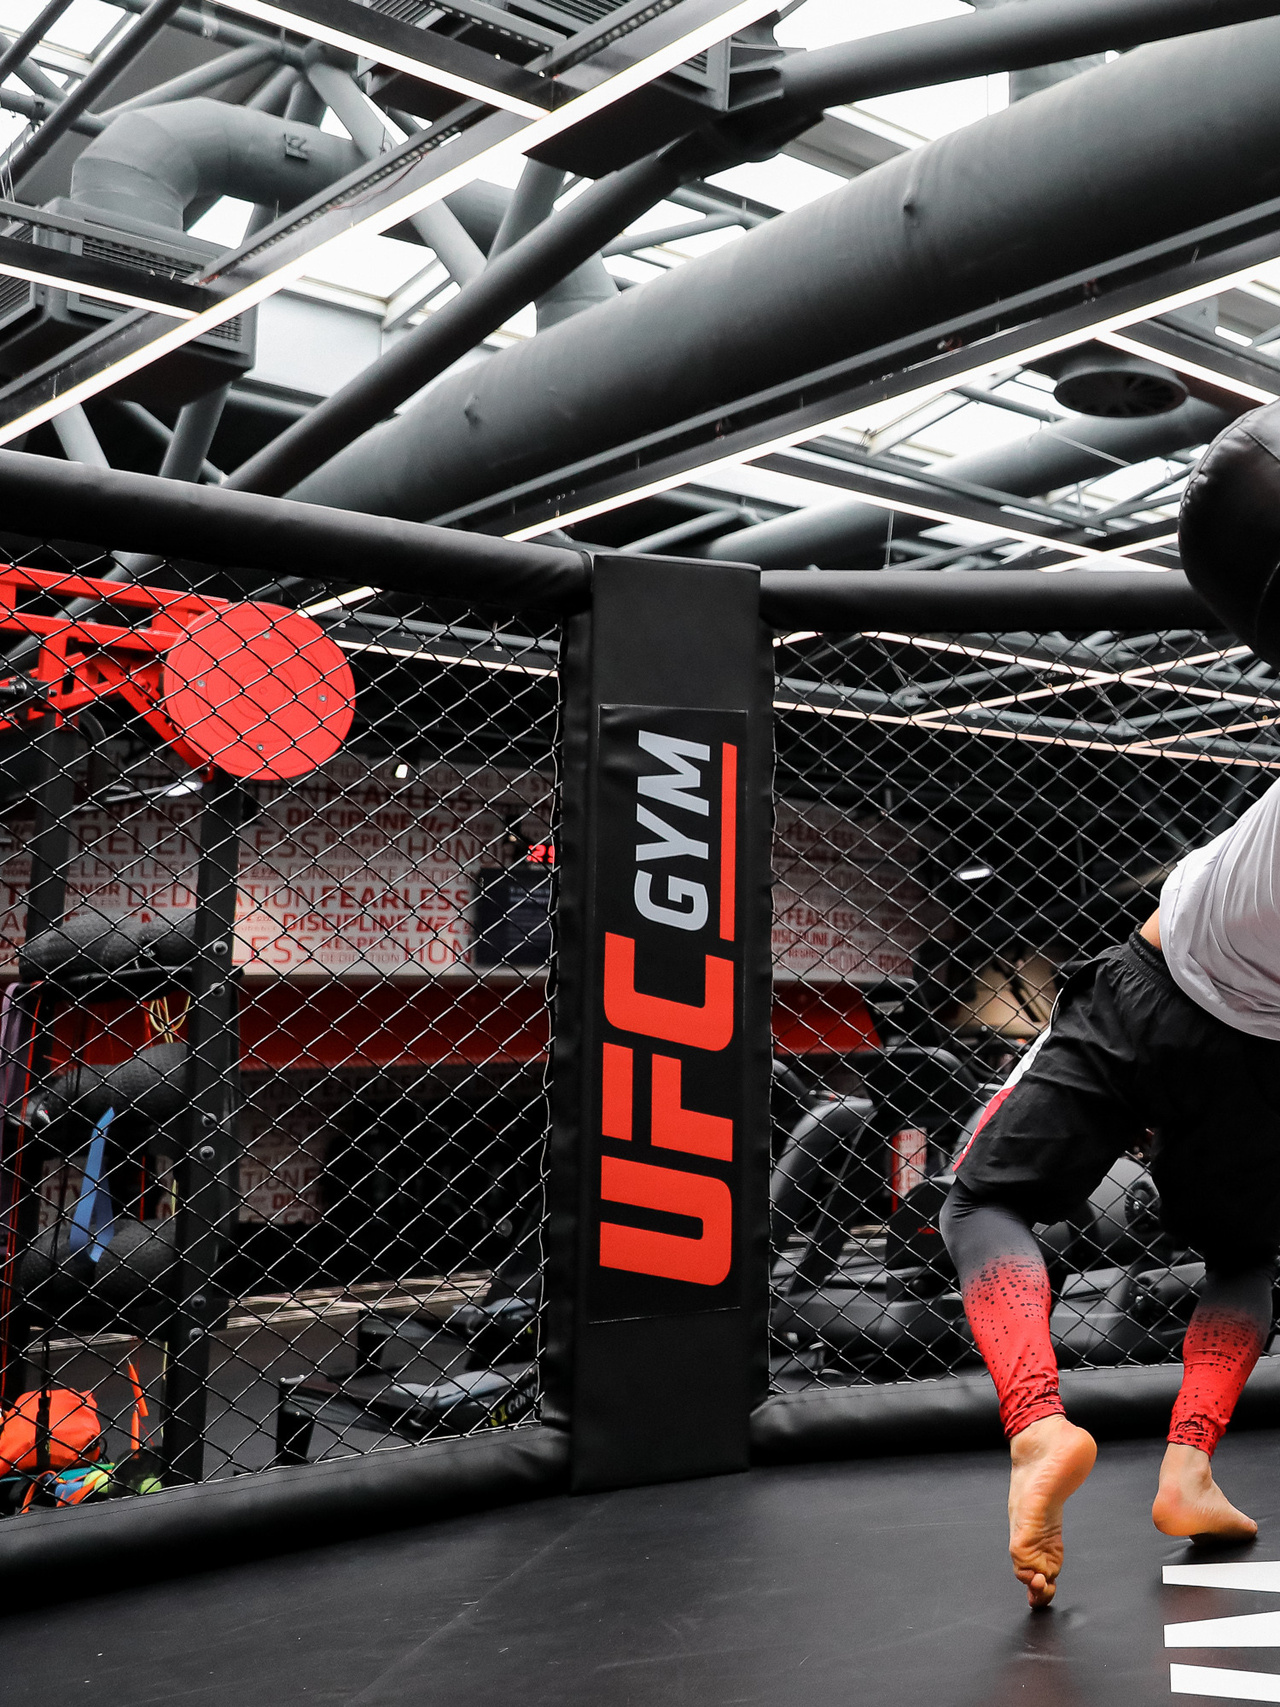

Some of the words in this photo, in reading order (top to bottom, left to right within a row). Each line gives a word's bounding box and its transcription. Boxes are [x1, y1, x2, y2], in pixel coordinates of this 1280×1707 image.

[634, 730, 710, 931] GYM
[66, 882, 121, 896] ONOR
[322, 885, 471, 912] FEARLESS
[283, 914, 409, 932] DISCIPLINE
[405, 937, 472, 965] HON
[600, 932, 734, 1286] UFC
